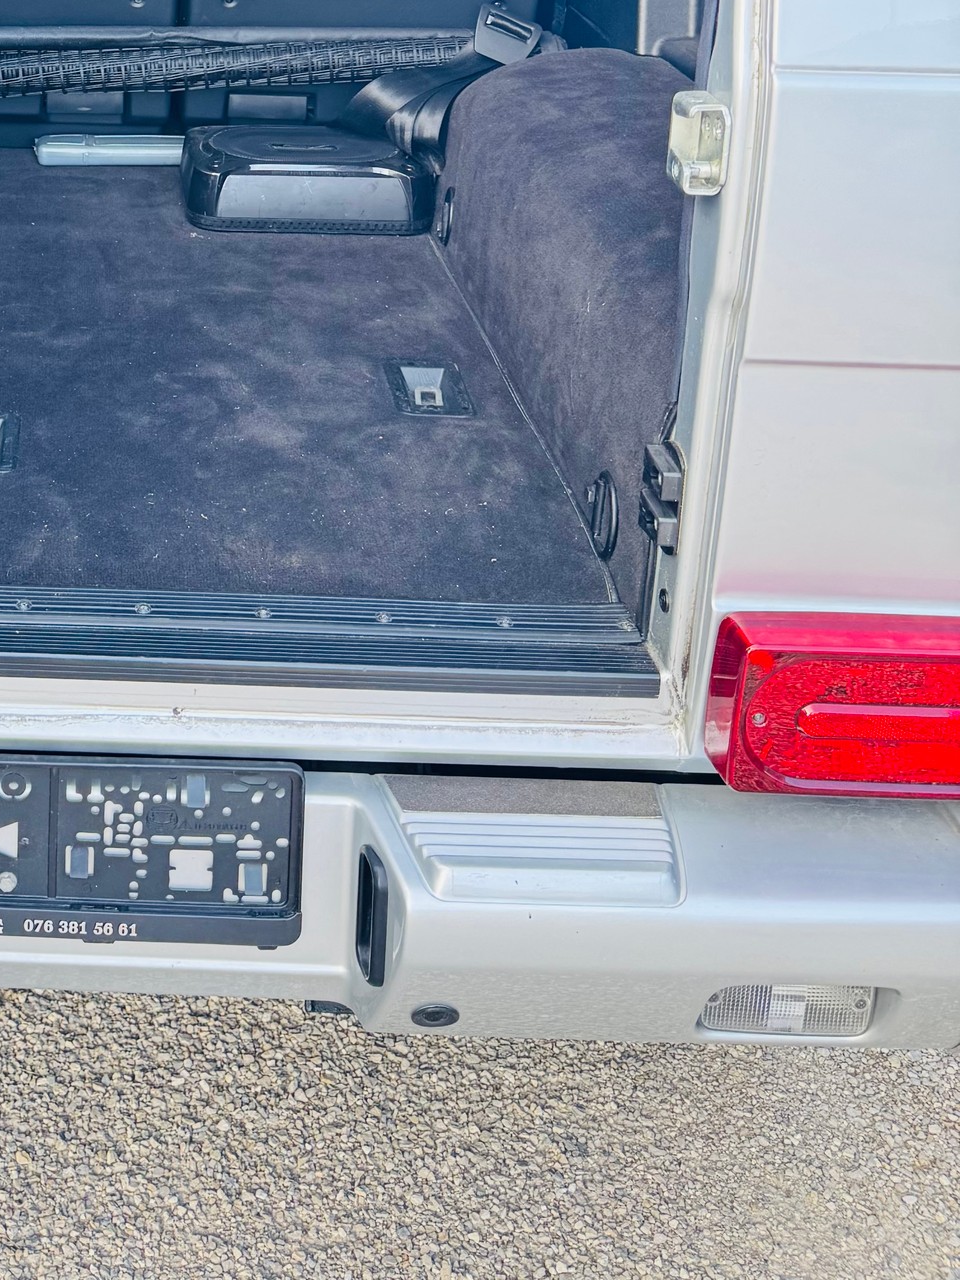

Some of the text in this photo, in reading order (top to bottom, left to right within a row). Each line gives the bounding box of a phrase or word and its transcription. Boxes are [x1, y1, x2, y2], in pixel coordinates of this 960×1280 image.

[23, 918, 138, 937] 076 381 56 61
